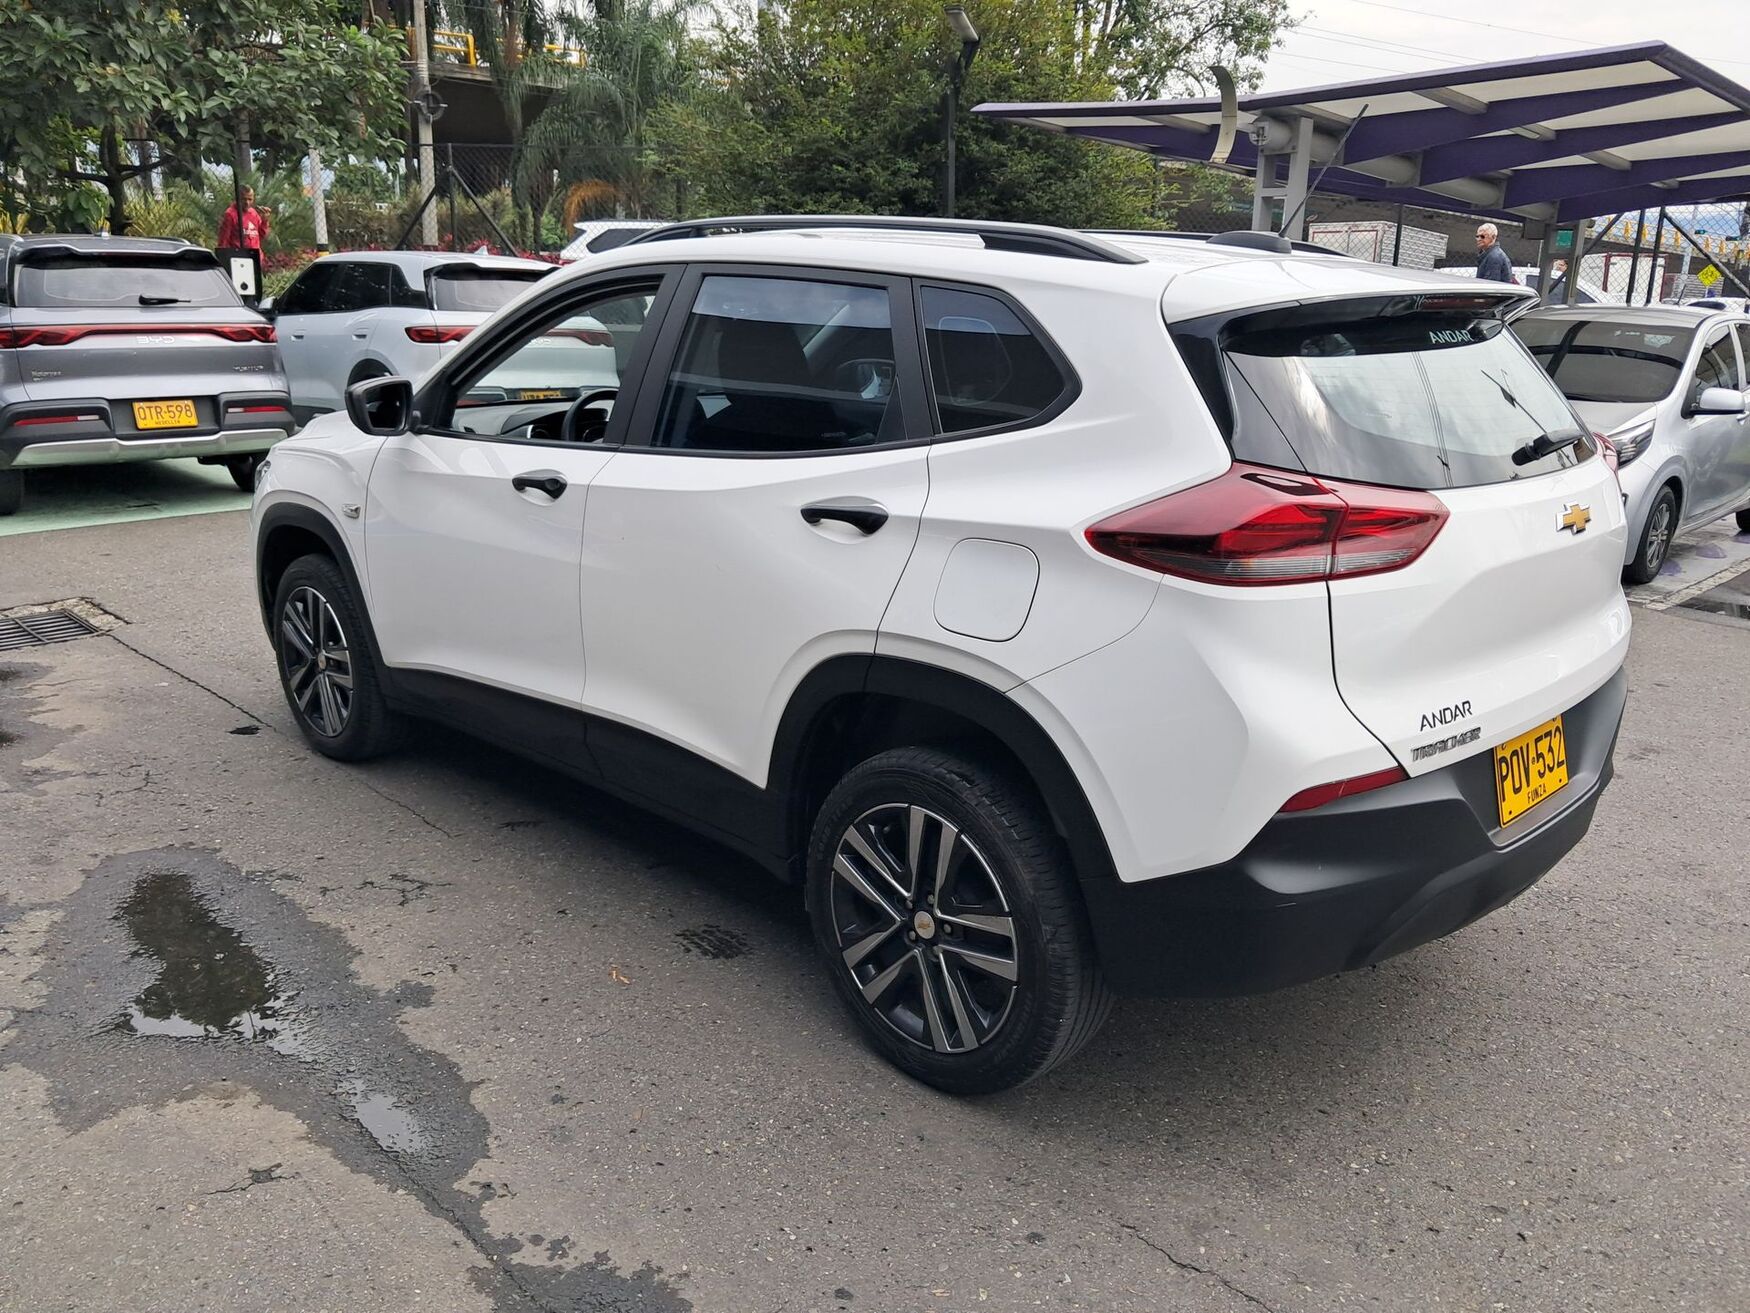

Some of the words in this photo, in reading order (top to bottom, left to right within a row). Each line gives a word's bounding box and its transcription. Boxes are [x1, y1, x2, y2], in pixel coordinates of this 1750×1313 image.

[136, 335, 176, 344] BYD
[1429, 329, 1475, 344] ANDAR
[1419, 700, 1473, 732] ANDAR
[1411, 726, 1482, 762] TRACKER
[1526, 783, 1548, 804] FUNZA
